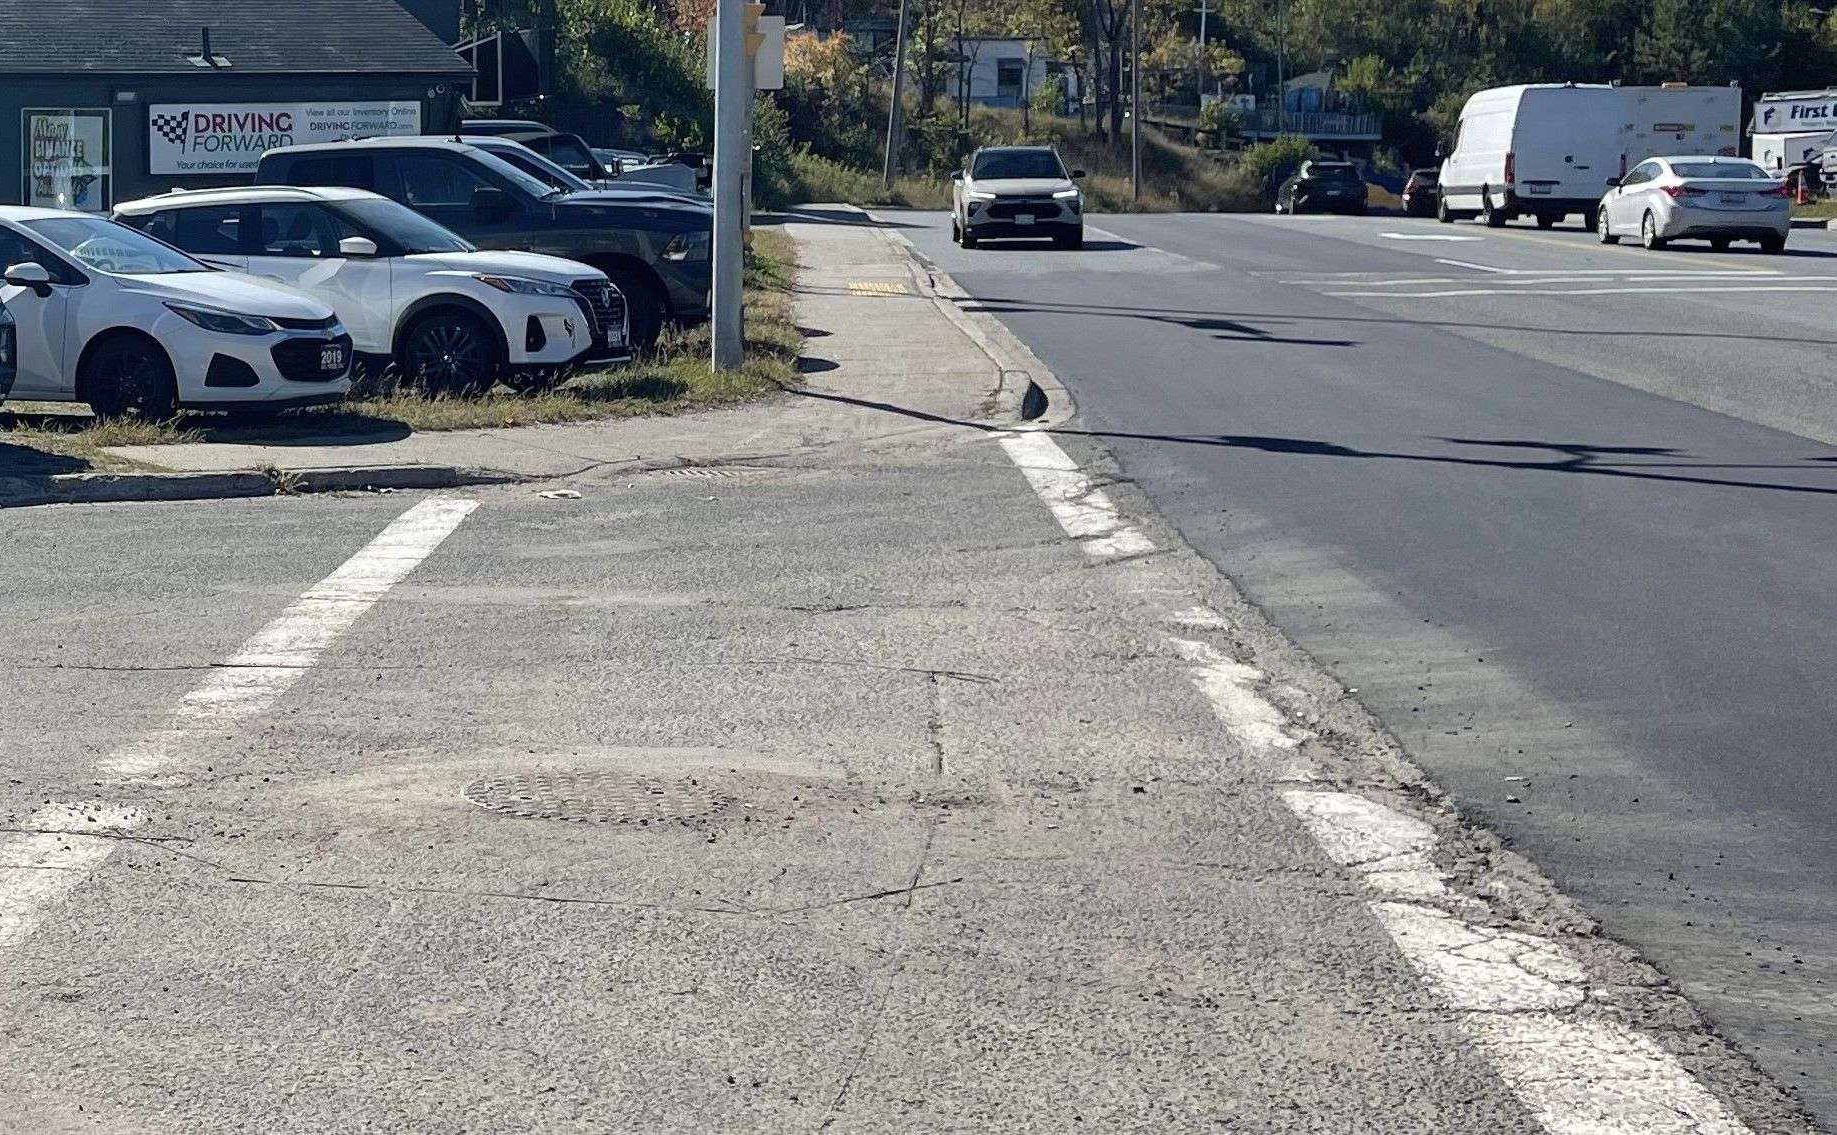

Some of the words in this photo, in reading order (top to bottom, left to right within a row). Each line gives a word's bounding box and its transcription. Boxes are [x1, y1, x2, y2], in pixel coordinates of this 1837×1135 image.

[1791, 104, 1828, 119] First
[194, 111, 293, 133] DRIVING
[192, 134, 294, 152] FORWARD
[177, 160, 195, 169] Your
[197, 160, 224, 169] choice
[225, 159, 238, 169] for
[321, 350, 342, 364] 2019
